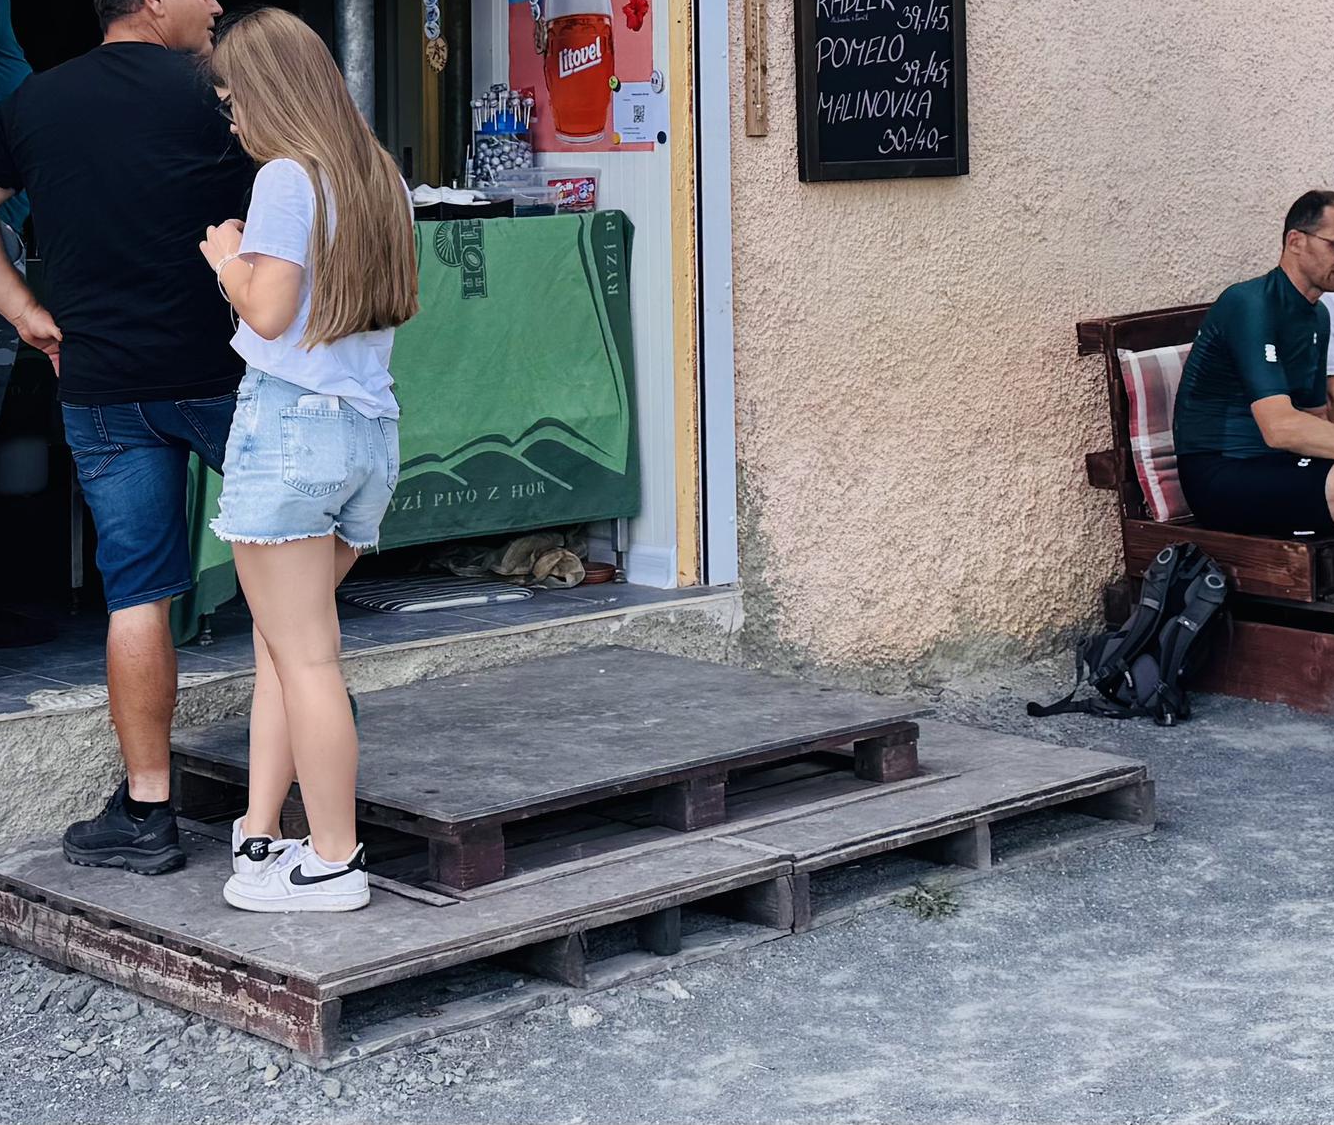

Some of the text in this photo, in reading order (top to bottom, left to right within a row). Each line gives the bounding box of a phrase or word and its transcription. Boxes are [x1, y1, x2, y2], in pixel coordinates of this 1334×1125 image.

[558, 36, 603, 79] Litovel
[816, 33, 905, 73] POMELO
[817, 89, 932, 125] MALINOVKA
[434, 489, 477, 507] PIVO
[488, 486, 500, 500] Z
[511, 481, 546, 498] HOR
